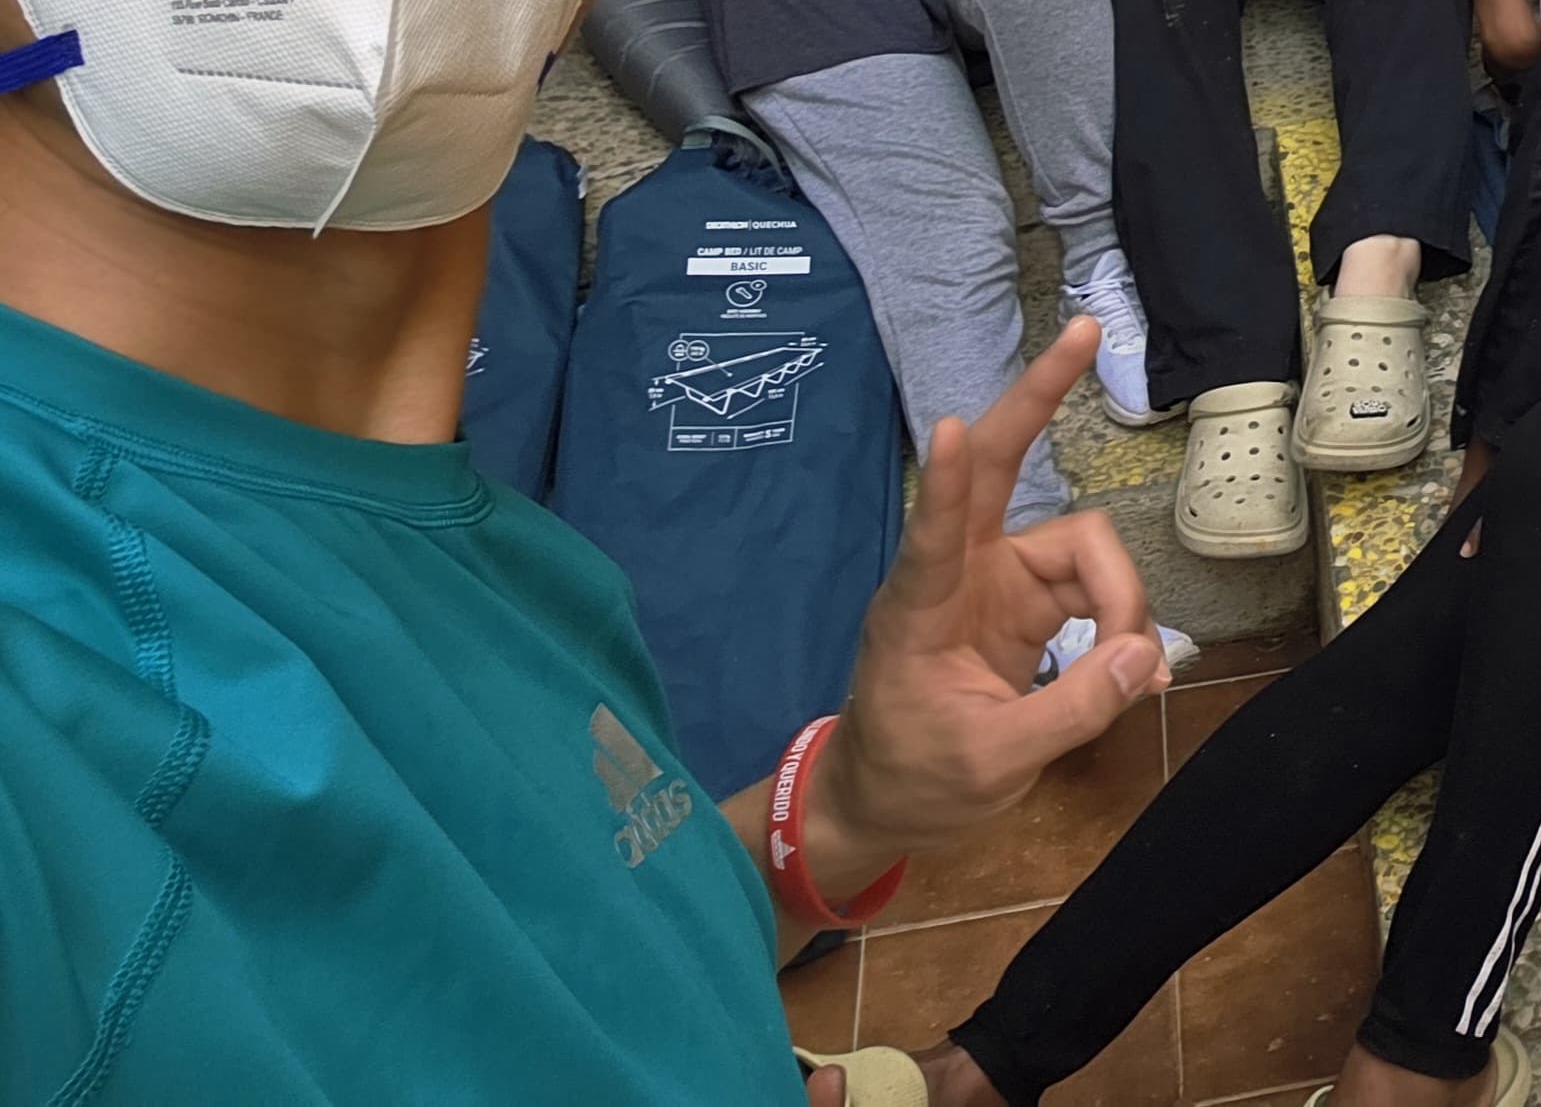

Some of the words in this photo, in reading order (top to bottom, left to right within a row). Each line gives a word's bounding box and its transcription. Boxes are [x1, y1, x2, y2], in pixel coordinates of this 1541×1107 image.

[751, 220, 798, 229] QUECHUA
[777, 246, 803, 255] CAMP
[730, 261, 768, 272] BASIC
[772, 761, 800, 822] QUERIDO
